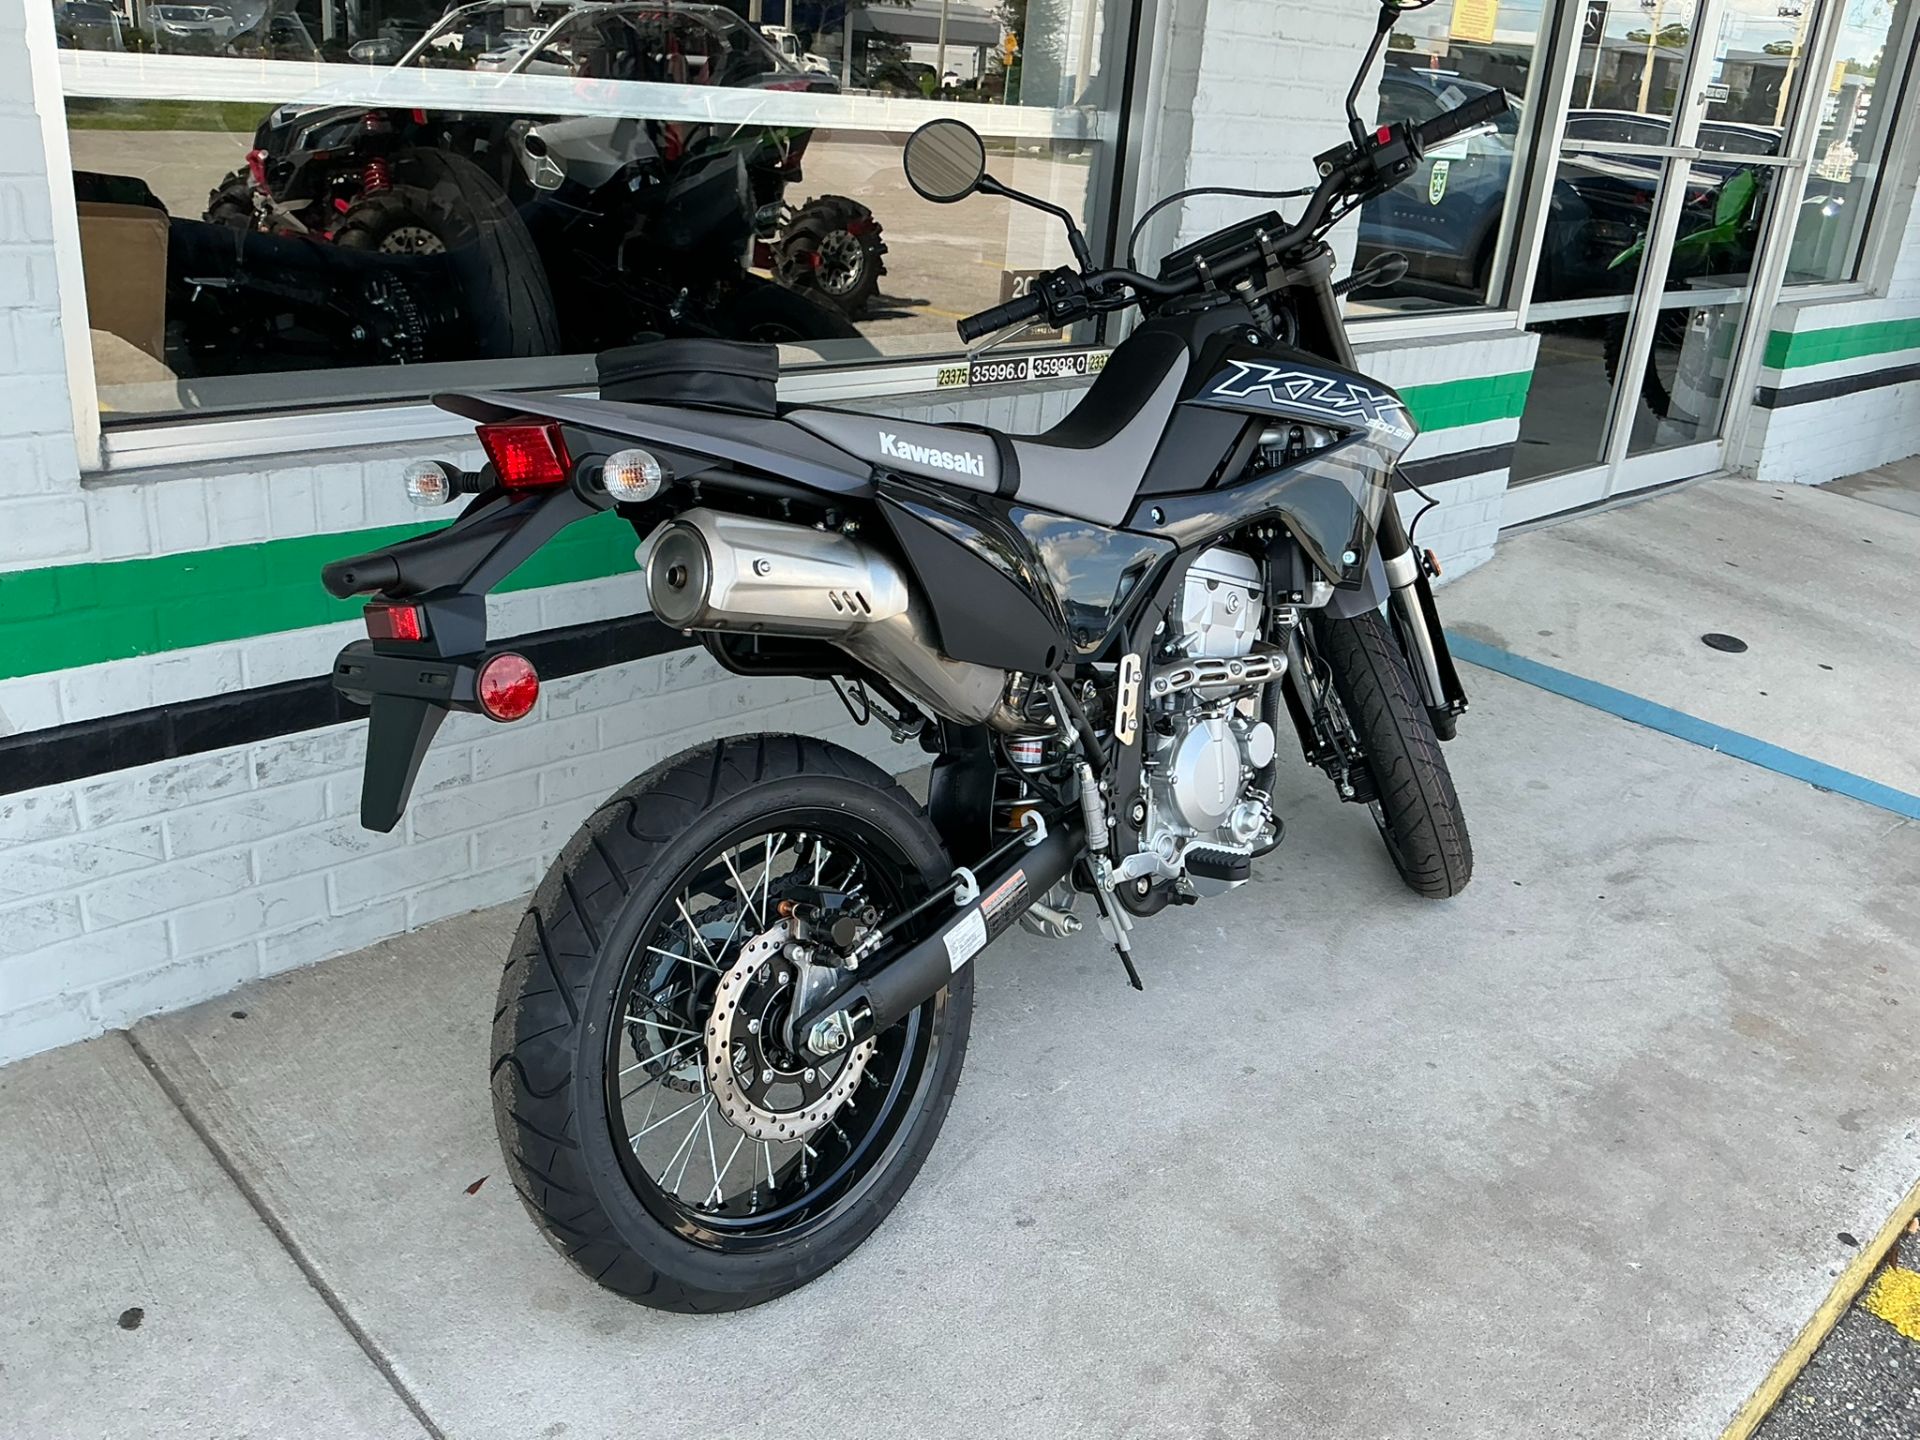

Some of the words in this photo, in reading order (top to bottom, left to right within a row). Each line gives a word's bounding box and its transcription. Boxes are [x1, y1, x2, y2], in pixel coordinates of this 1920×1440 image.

[939, 368, 967, 385] 23375
[972, 362, 1027, 382] 35996.0
[1034, 356, 1085, 376] 35998.0
[1211, 359, 1406, 424] KLX
[879, 432, 985, 477] Kawasaki
